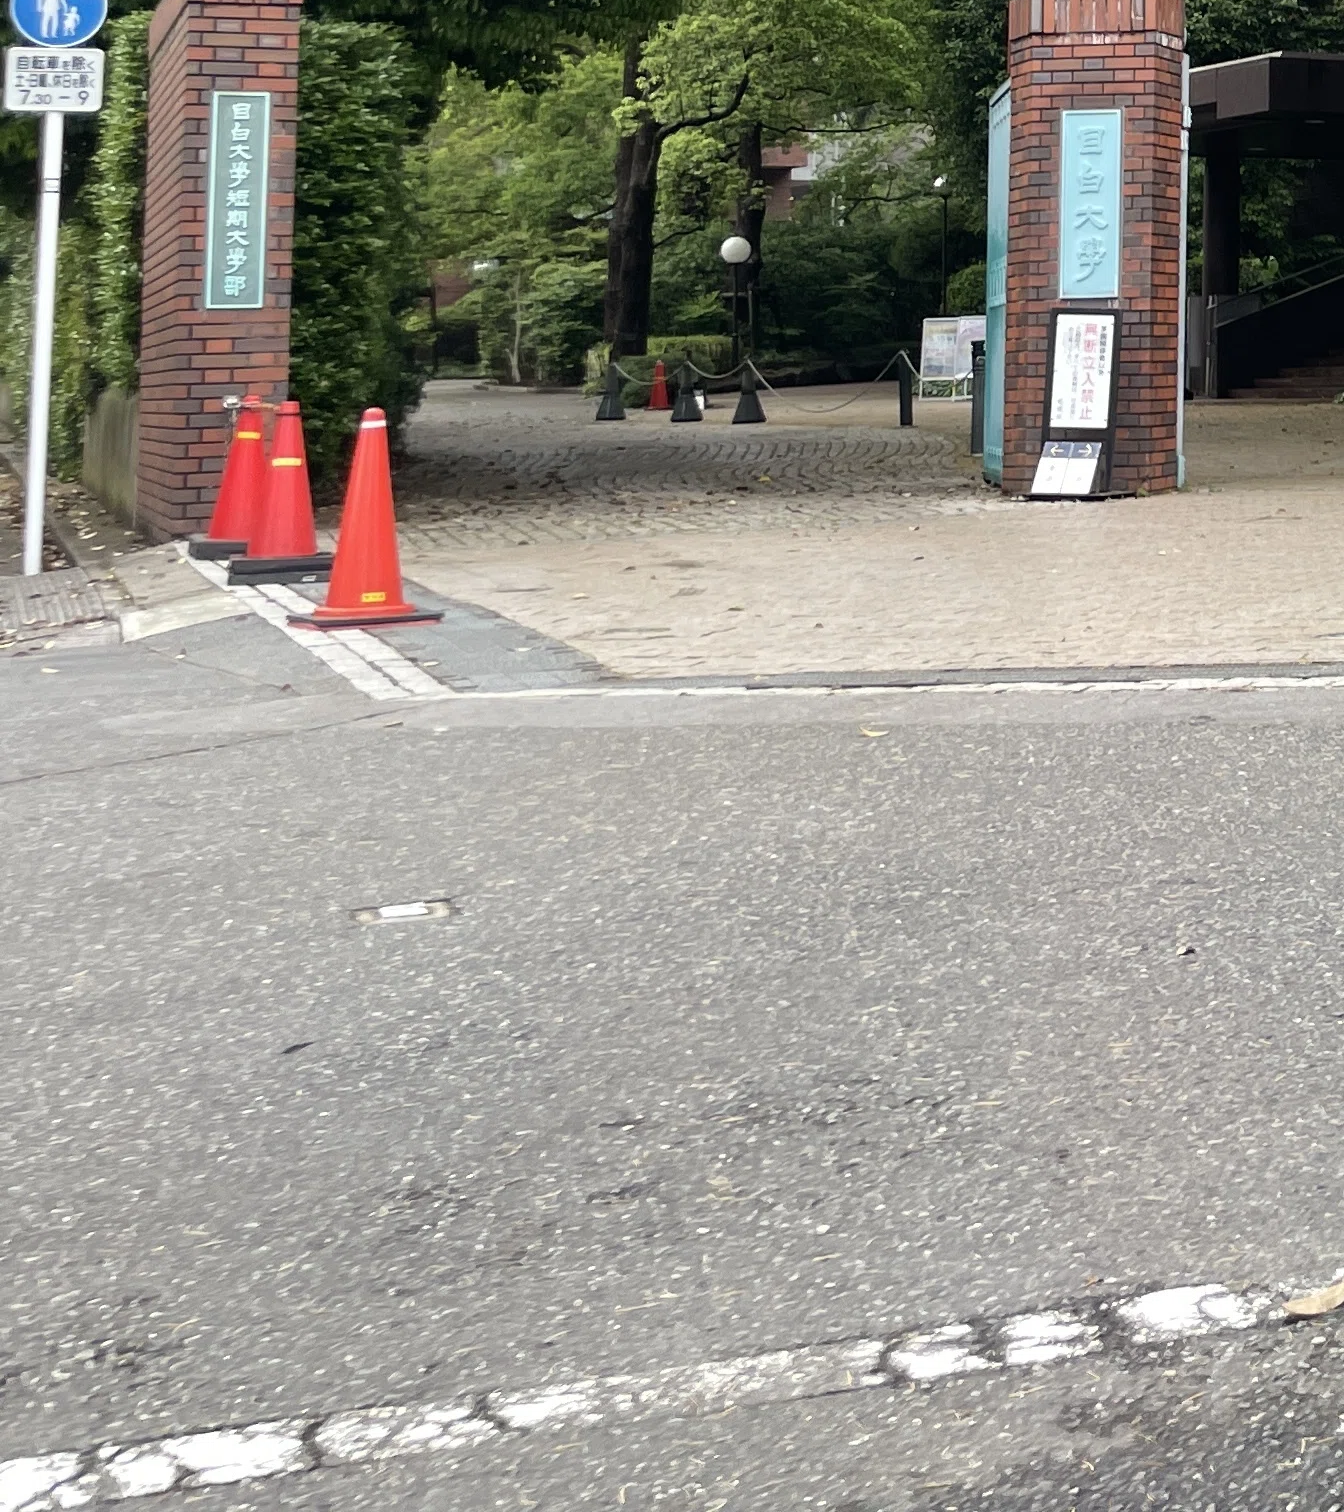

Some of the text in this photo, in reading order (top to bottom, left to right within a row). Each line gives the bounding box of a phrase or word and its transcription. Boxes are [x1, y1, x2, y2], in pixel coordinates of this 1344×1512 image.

[17, 55, 95, 71] 自転車を除く
[1079, 323, 1098, 420] 無断立入禁止
